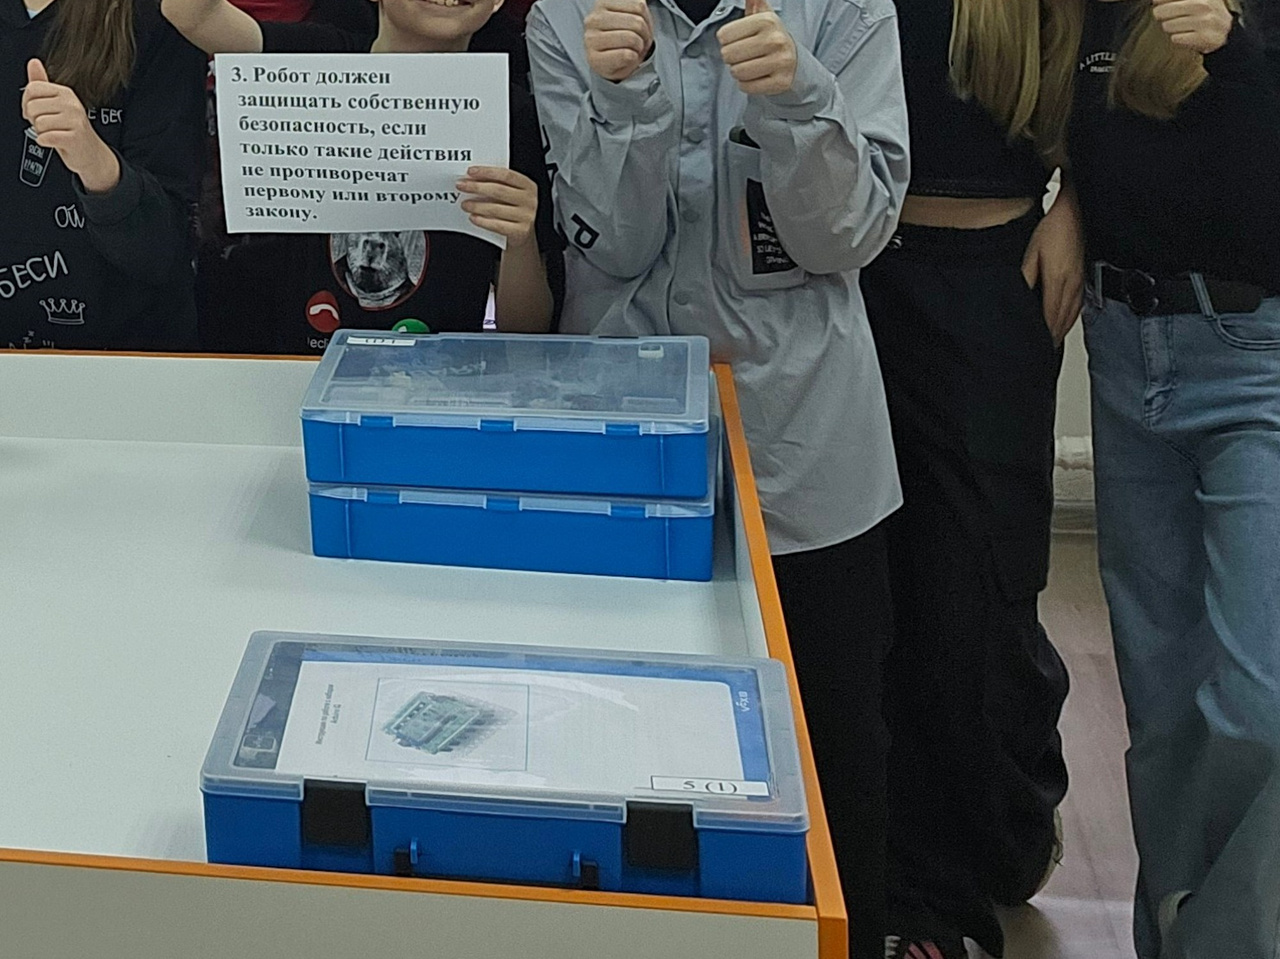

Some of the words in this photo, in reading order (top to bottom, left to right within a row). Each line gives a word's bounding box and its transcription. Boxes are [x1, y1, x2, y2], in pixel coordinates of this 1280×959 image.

[231, 67, 247, 82] 3.
[254, 67, 311, 83] Робот
[316, 72, 390, 85] должен
[238, 95, 341, 109] защищать
[348, 93, 479, 114] собственную
[239, 116, 375, 137] безопасность,
[382, 123, 426, 135] если
[240, 143, 308, 156] только
[314, 146, 372, 158] такие
[377, 145, 471, 161] действия
[242, 166, 263, 176] не
[270, 167, 409, 184] противоречат
[244, 187, 325, 203] первому
[332, 191, 369, 201] или
[376, 192, 460, 204] второму
[54, 204, 84, 228] Ой
[246, 207, 317, 222] закону.
[683, 781, 695, 790] 5
[705, 782, 738, 794] (1)
